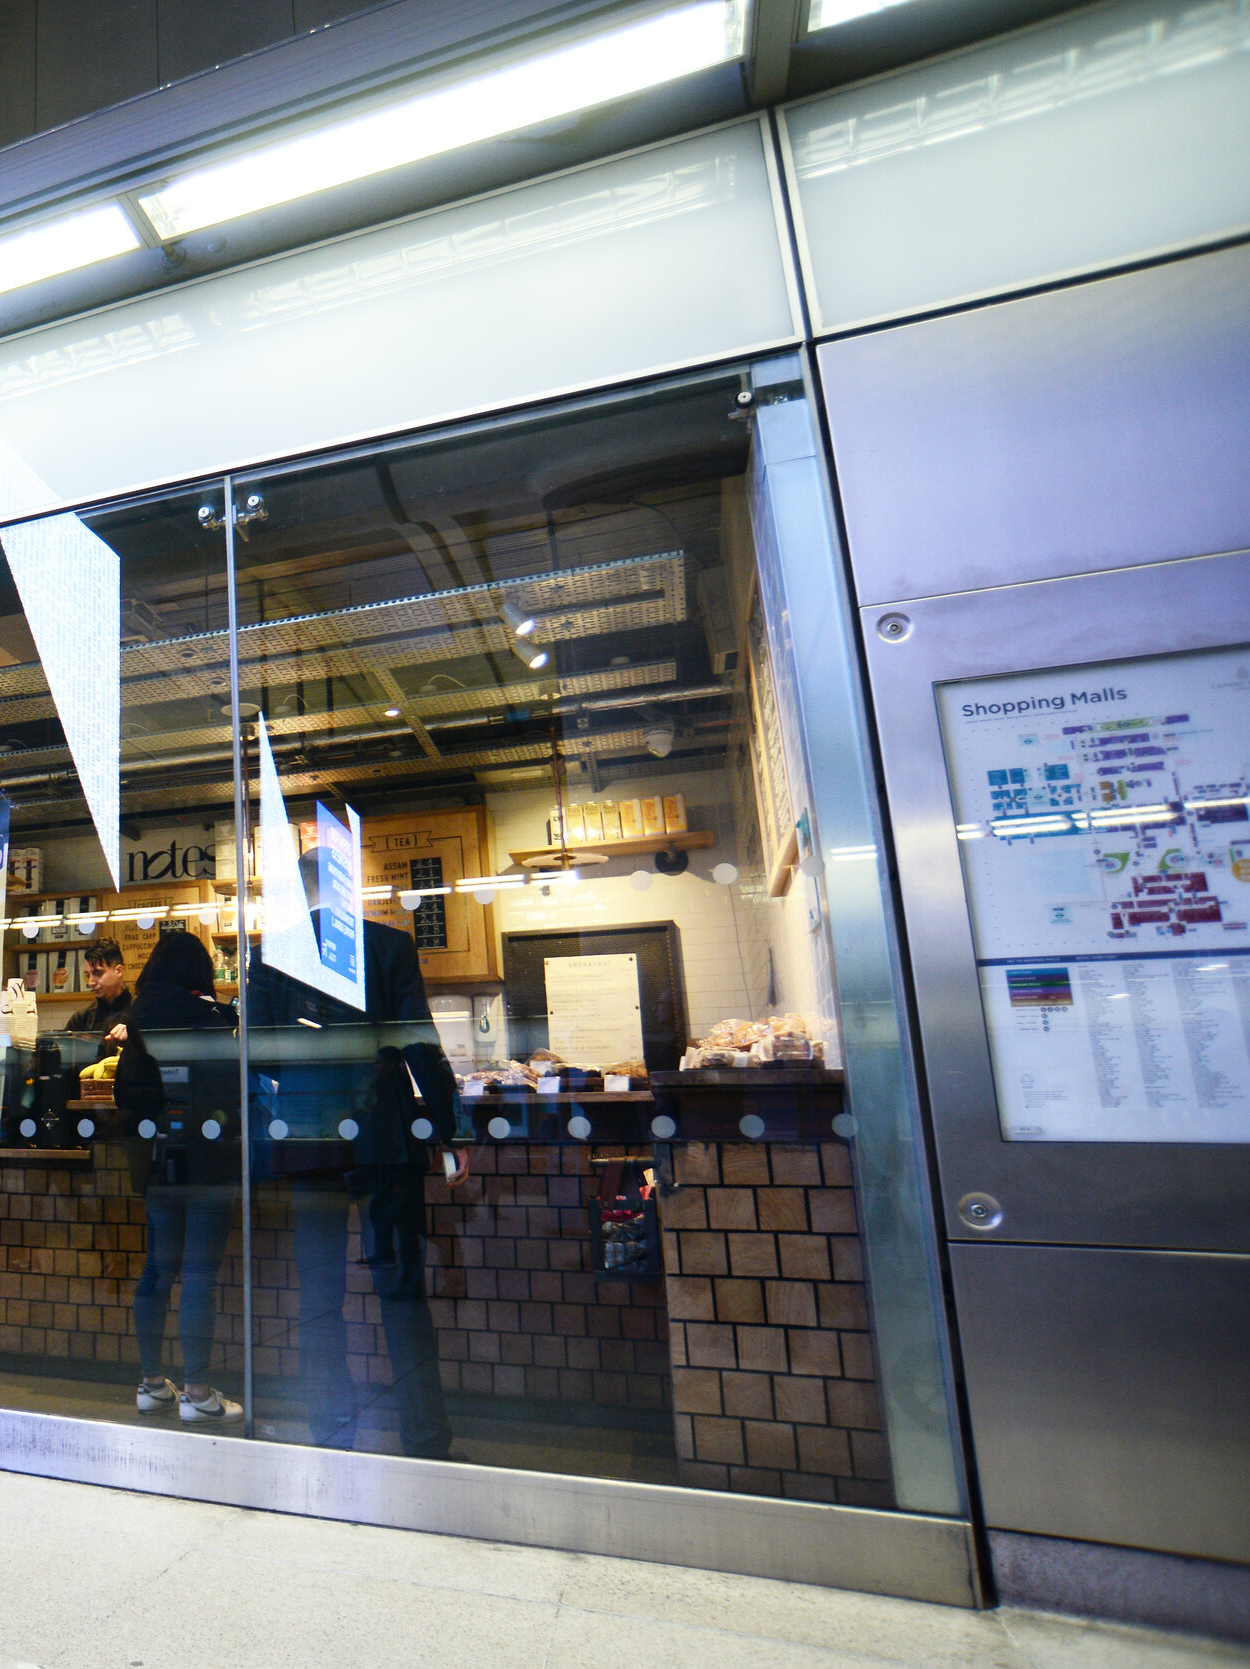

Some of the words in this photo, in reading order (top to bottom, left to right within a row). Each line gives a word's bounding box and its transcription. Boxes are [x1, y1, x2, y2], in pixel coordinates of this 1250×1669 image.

[961, 693, 1066, 718] Shopping
[1070, 687, 1128, 705] Malls
[394, 838, 410, 847] TEA
[367, 874, 389, 883] FRESH
[391, 872, 408, 881] MINT
